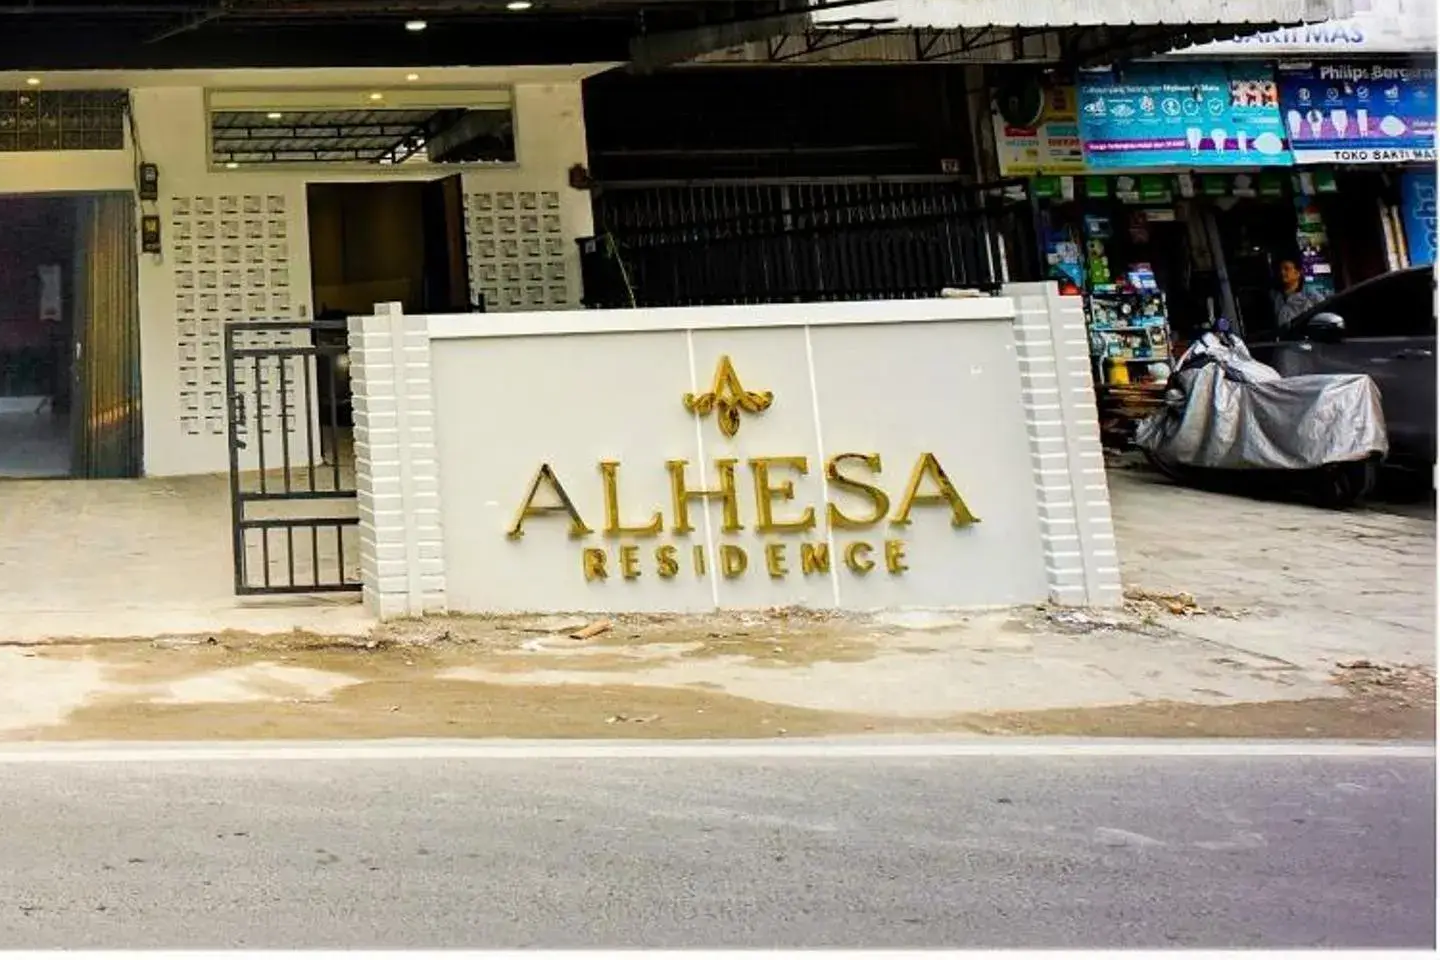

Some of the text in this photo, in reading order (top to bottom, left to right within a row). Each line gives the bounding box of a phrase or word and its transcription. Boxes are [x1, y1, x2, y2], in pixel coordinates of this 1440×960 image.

[1334, 151, 1367, 160] TOKO
[1373, 150, 1410, 160] SAKTI
[507, 452, 981, 540] ALHESA
[582, 540, 910, 582] RESIDENCE
